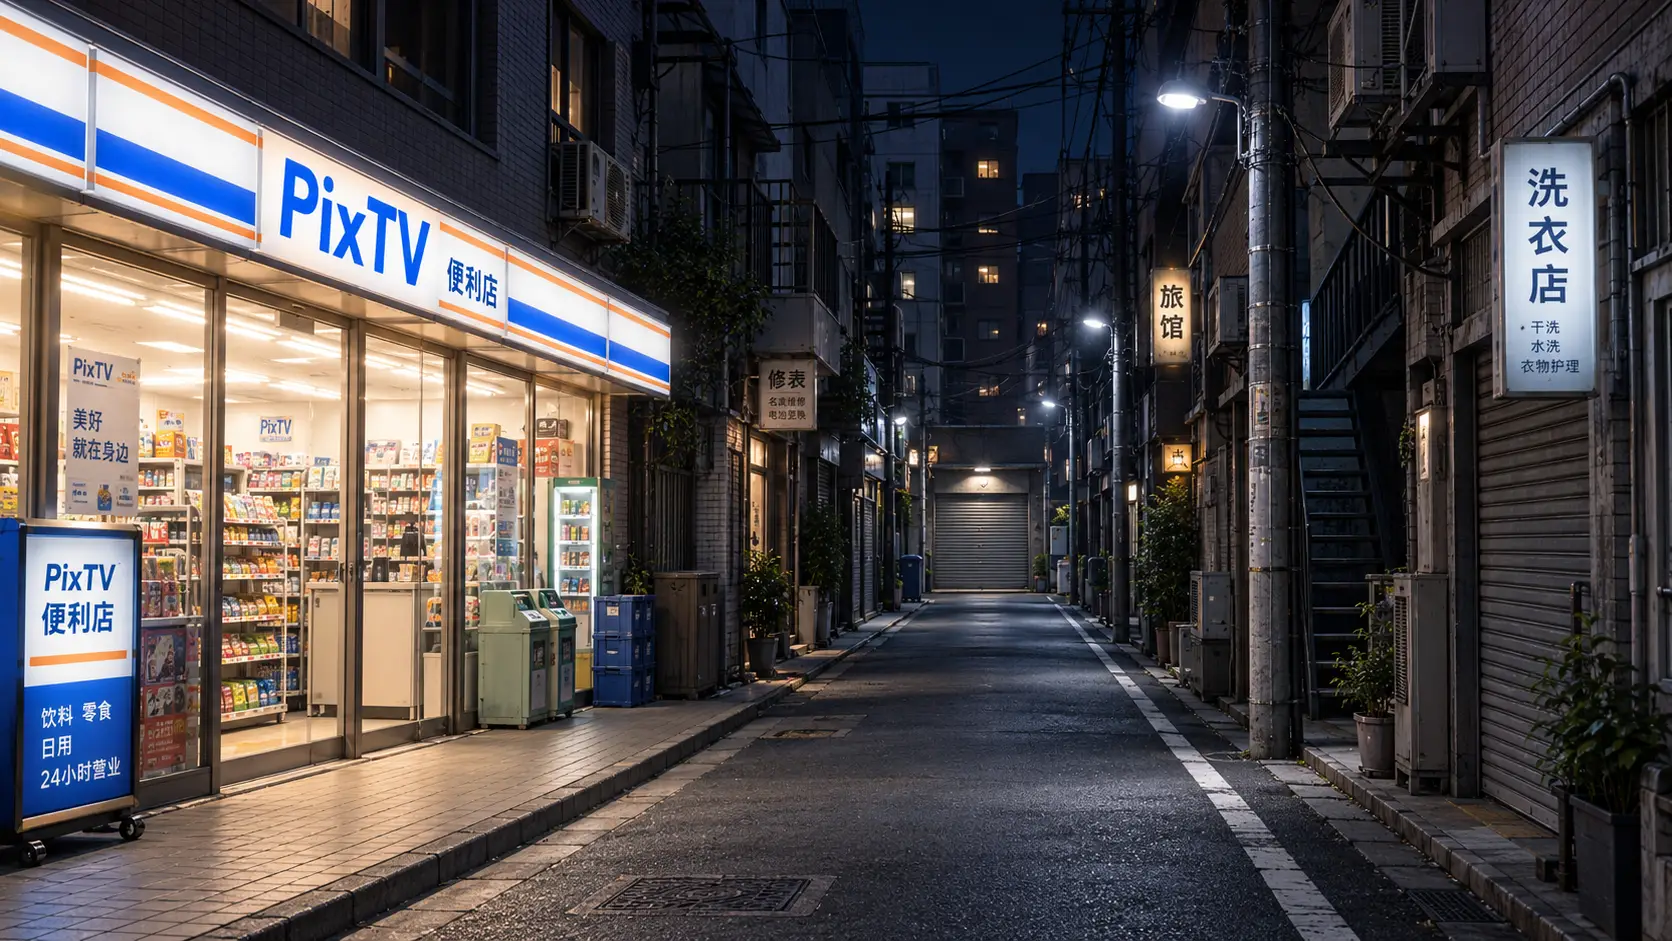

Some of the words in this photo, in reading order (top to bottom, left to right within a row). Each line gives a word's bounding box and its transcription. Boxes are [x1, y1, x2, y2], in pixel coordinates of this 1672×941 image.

[279, 157, 431, 287] PixTV
[447, 257, 498, 309] 便利店
[1527, 167, 1569, 304] 洗衣店
[1160, 284, 1184, 339] 旅馆
[1530, 320, 1560, 334] 干洗
[1530, 339, 1561, 353] 水洗
[73, 357, 114, 381] PixTV
[768, 369, 806, 389] 修表
[1520, 359, 1580, 374] 衣物护理
[73, 407, 103, 432] 美好
[260, 419, 292, 435] PixTV
[72, 436, 129, 463] 就在身边
[44, 563, 116, 591] PixTV
[41, 601, 114, 636] 便利店
[41, 704, 74, 729] 饮料
[82, 700, 112, 722] 零食
[42, 735, 72, 759] 日用
[40, 756, 120, 789] 24小时营业
